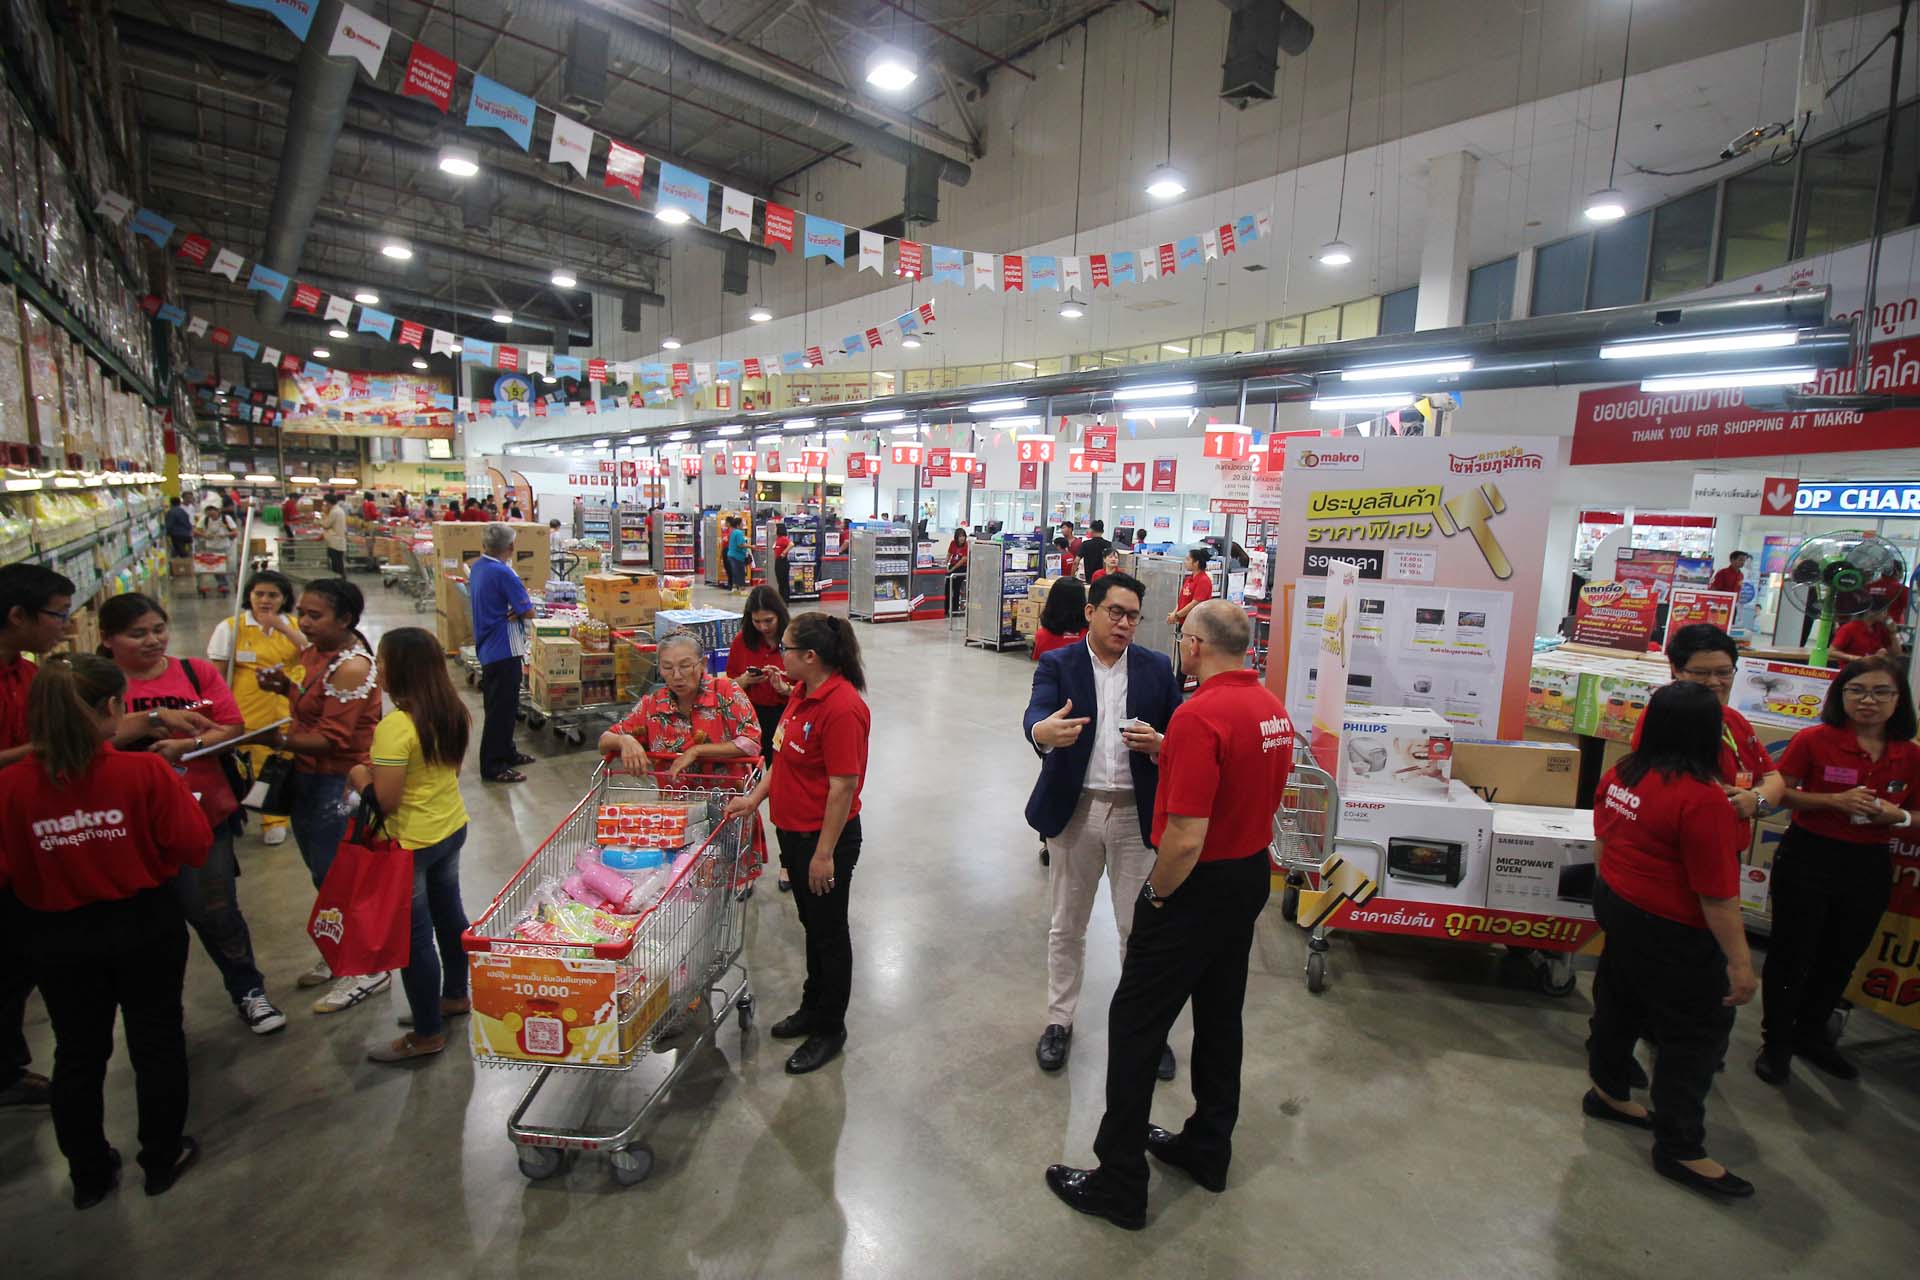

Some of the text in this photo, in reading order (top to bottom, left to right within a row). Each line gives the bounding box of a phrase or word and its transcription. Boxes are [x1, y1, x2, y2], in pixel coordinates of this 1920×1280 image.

[1632, 428, 1664, 442] THANK
[1669, 426, 1691, 439] YOU
[1696, 424, 1718, 437] FOR
[1724, 416, 1784, 435] SHOPPING
[1790, 414, 1807, 429] AT
[1022, 442, 1050, 460] 3 3
[1214, 434, 1245, 457] 1 1
[815, 452, 824, 465] 7
[964, 458, 972, 472] 6
[1073, 455, 1083, 471] 4
[1248, 453, 1261, 472] 2
[1320, 451, 1360, 463] makro
[1312, 487, 1436, 515] ประมูลสินค้า
[1794, 488, 1832, 510] OP
[1307, 520, 1432, 542] ราคาพิเศษ
[1775, 703, 1813, 716] 719
[1260, 714, 1291, 737] makro
[1343, 722, 1387, 734] PHILIPS
[1607, 783, 1641, 809] makro
[1344, 801, 1386, 810] SHARP
[32, 808, 125, 836] makro
[40, 826, 127, 851] คู่คิดธุรกิจคุณ
[1498, 837, 1535, 846] SAMSUNG
[1495, 865, 1522, 874] OVEN
[1496, 857, 1555, 869] MICROWAVE
[1349, 907, 1583, 943] ราคาเริ่มต้น ถูกเวอร์!!!
[513, 982, 569, 998] 10,000
